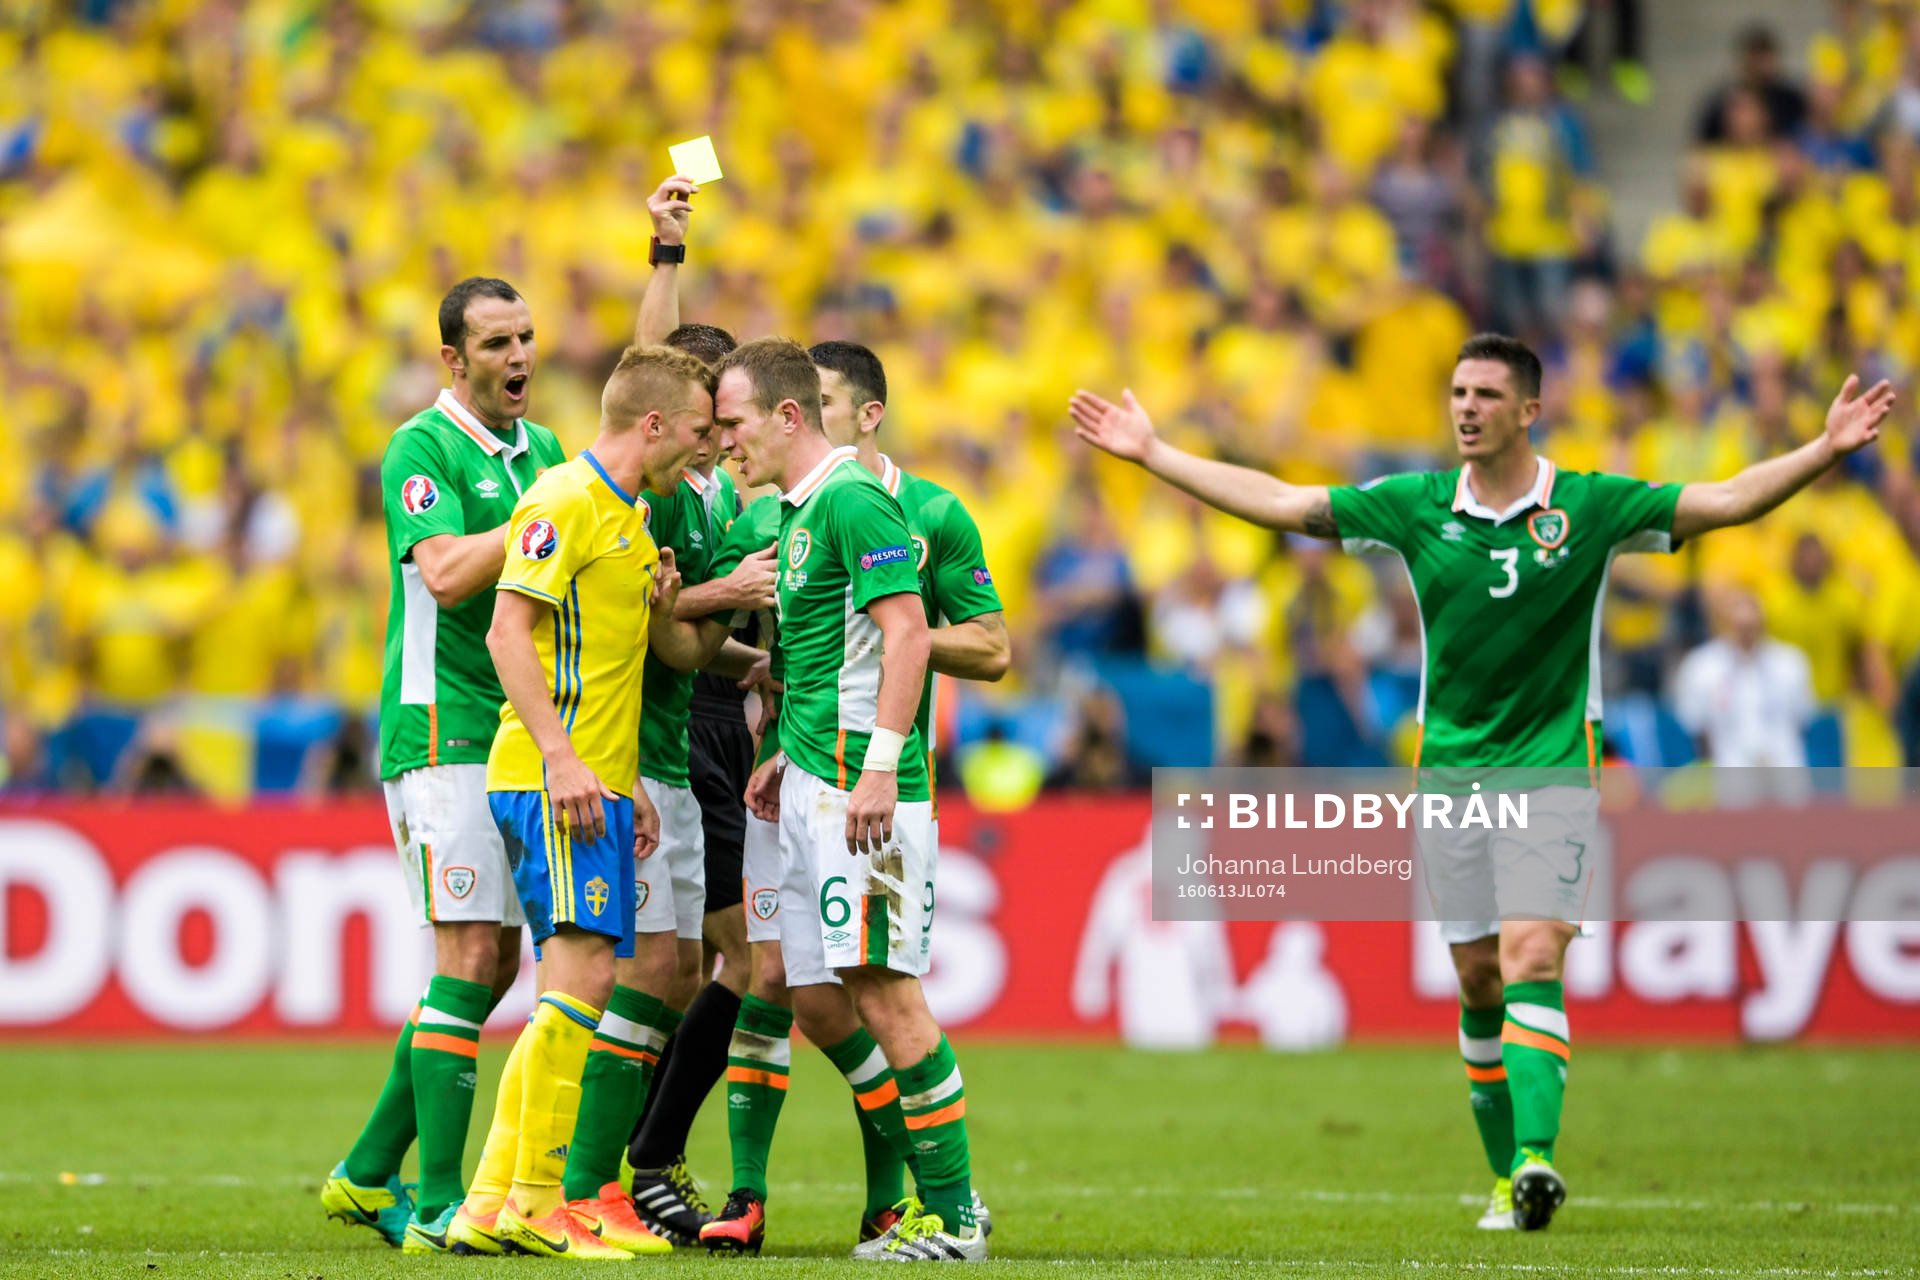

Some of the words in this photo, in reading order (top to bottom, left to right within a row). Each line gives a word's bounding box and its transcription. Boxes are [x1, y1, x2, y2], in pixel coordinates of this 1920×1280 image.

[871, 548, 907, 563] RESPECT
[1488, 547, 1519, 598] 3
[1557, 838, 1586, 885] 3
[819, 876, 851, 928] 6
